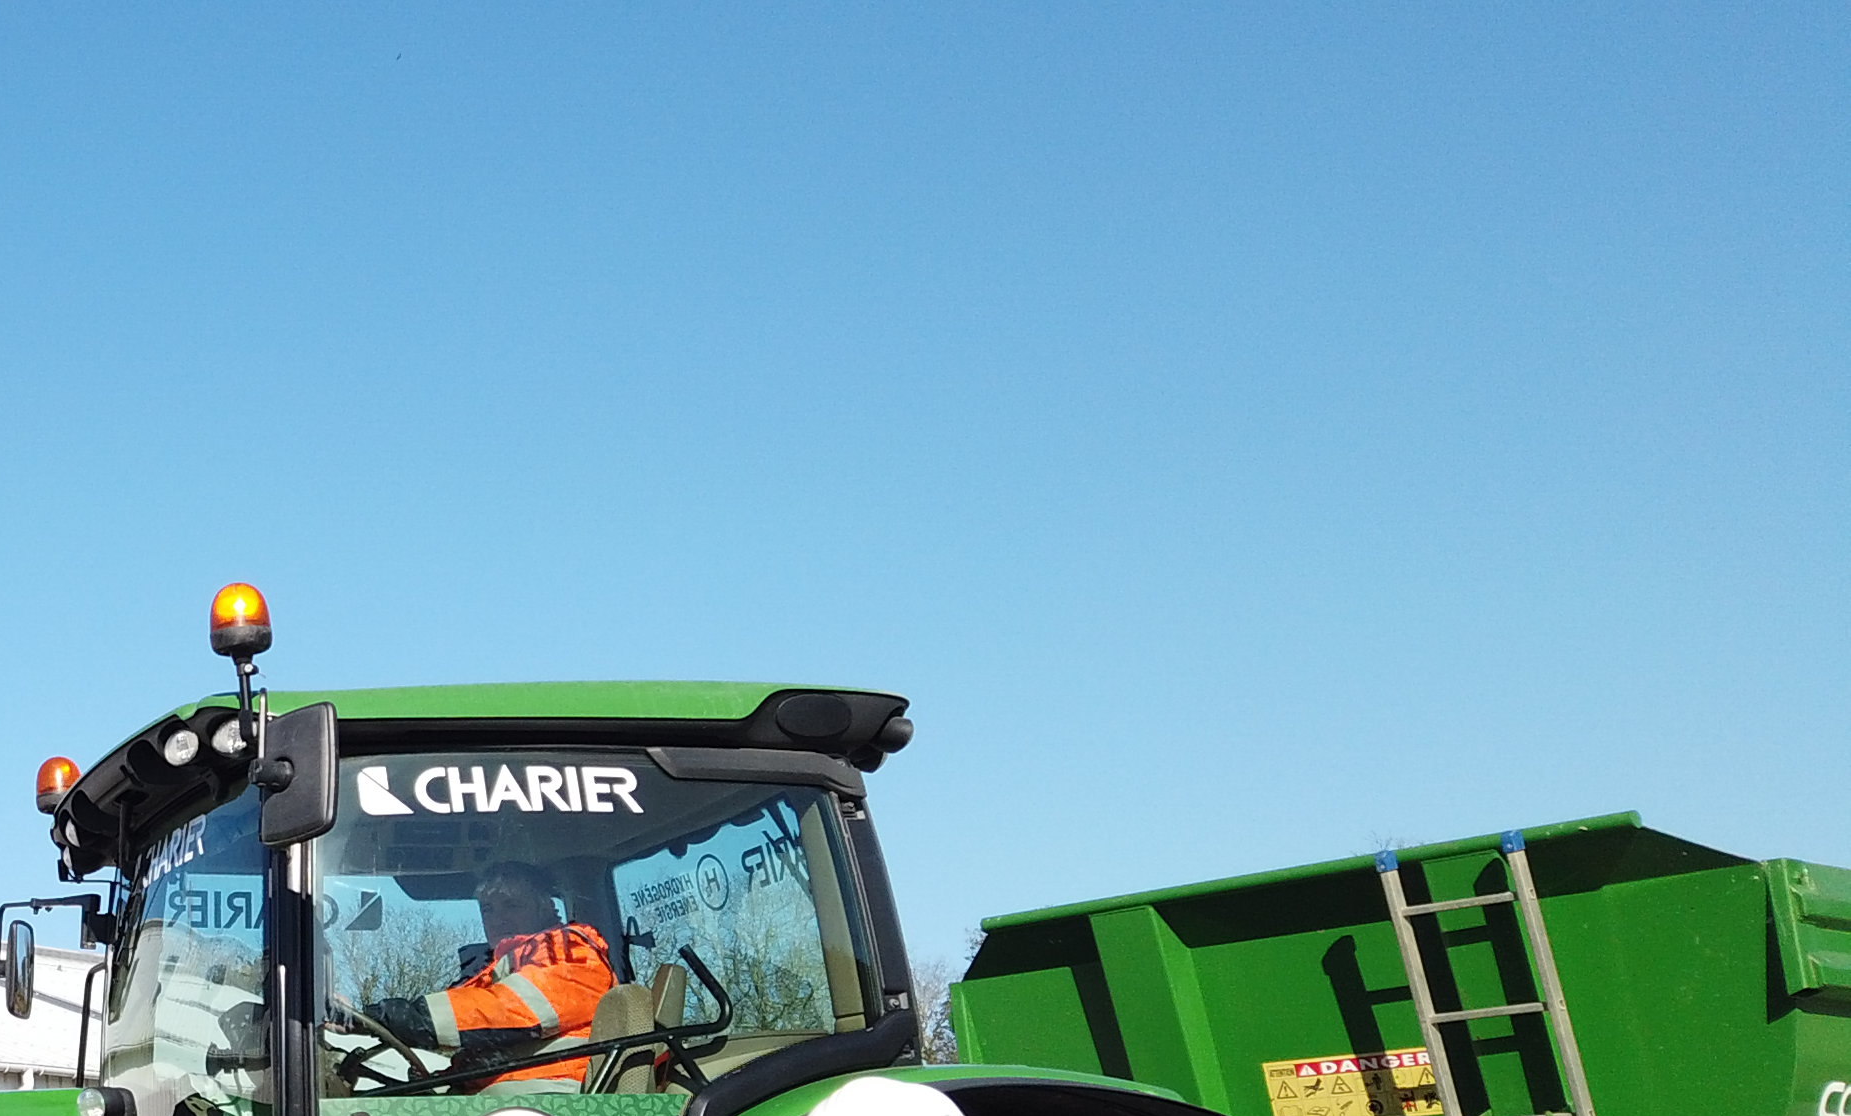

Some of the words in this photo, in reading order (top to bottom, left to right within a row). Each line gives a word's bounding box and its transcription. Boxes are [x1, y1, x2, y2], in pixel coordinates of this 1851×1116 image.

[414, 764, 644, 814] CHARIER
[142, 814, 207, 888] CHARIER
[1320, 1052, 1431, 1075] DANGER
